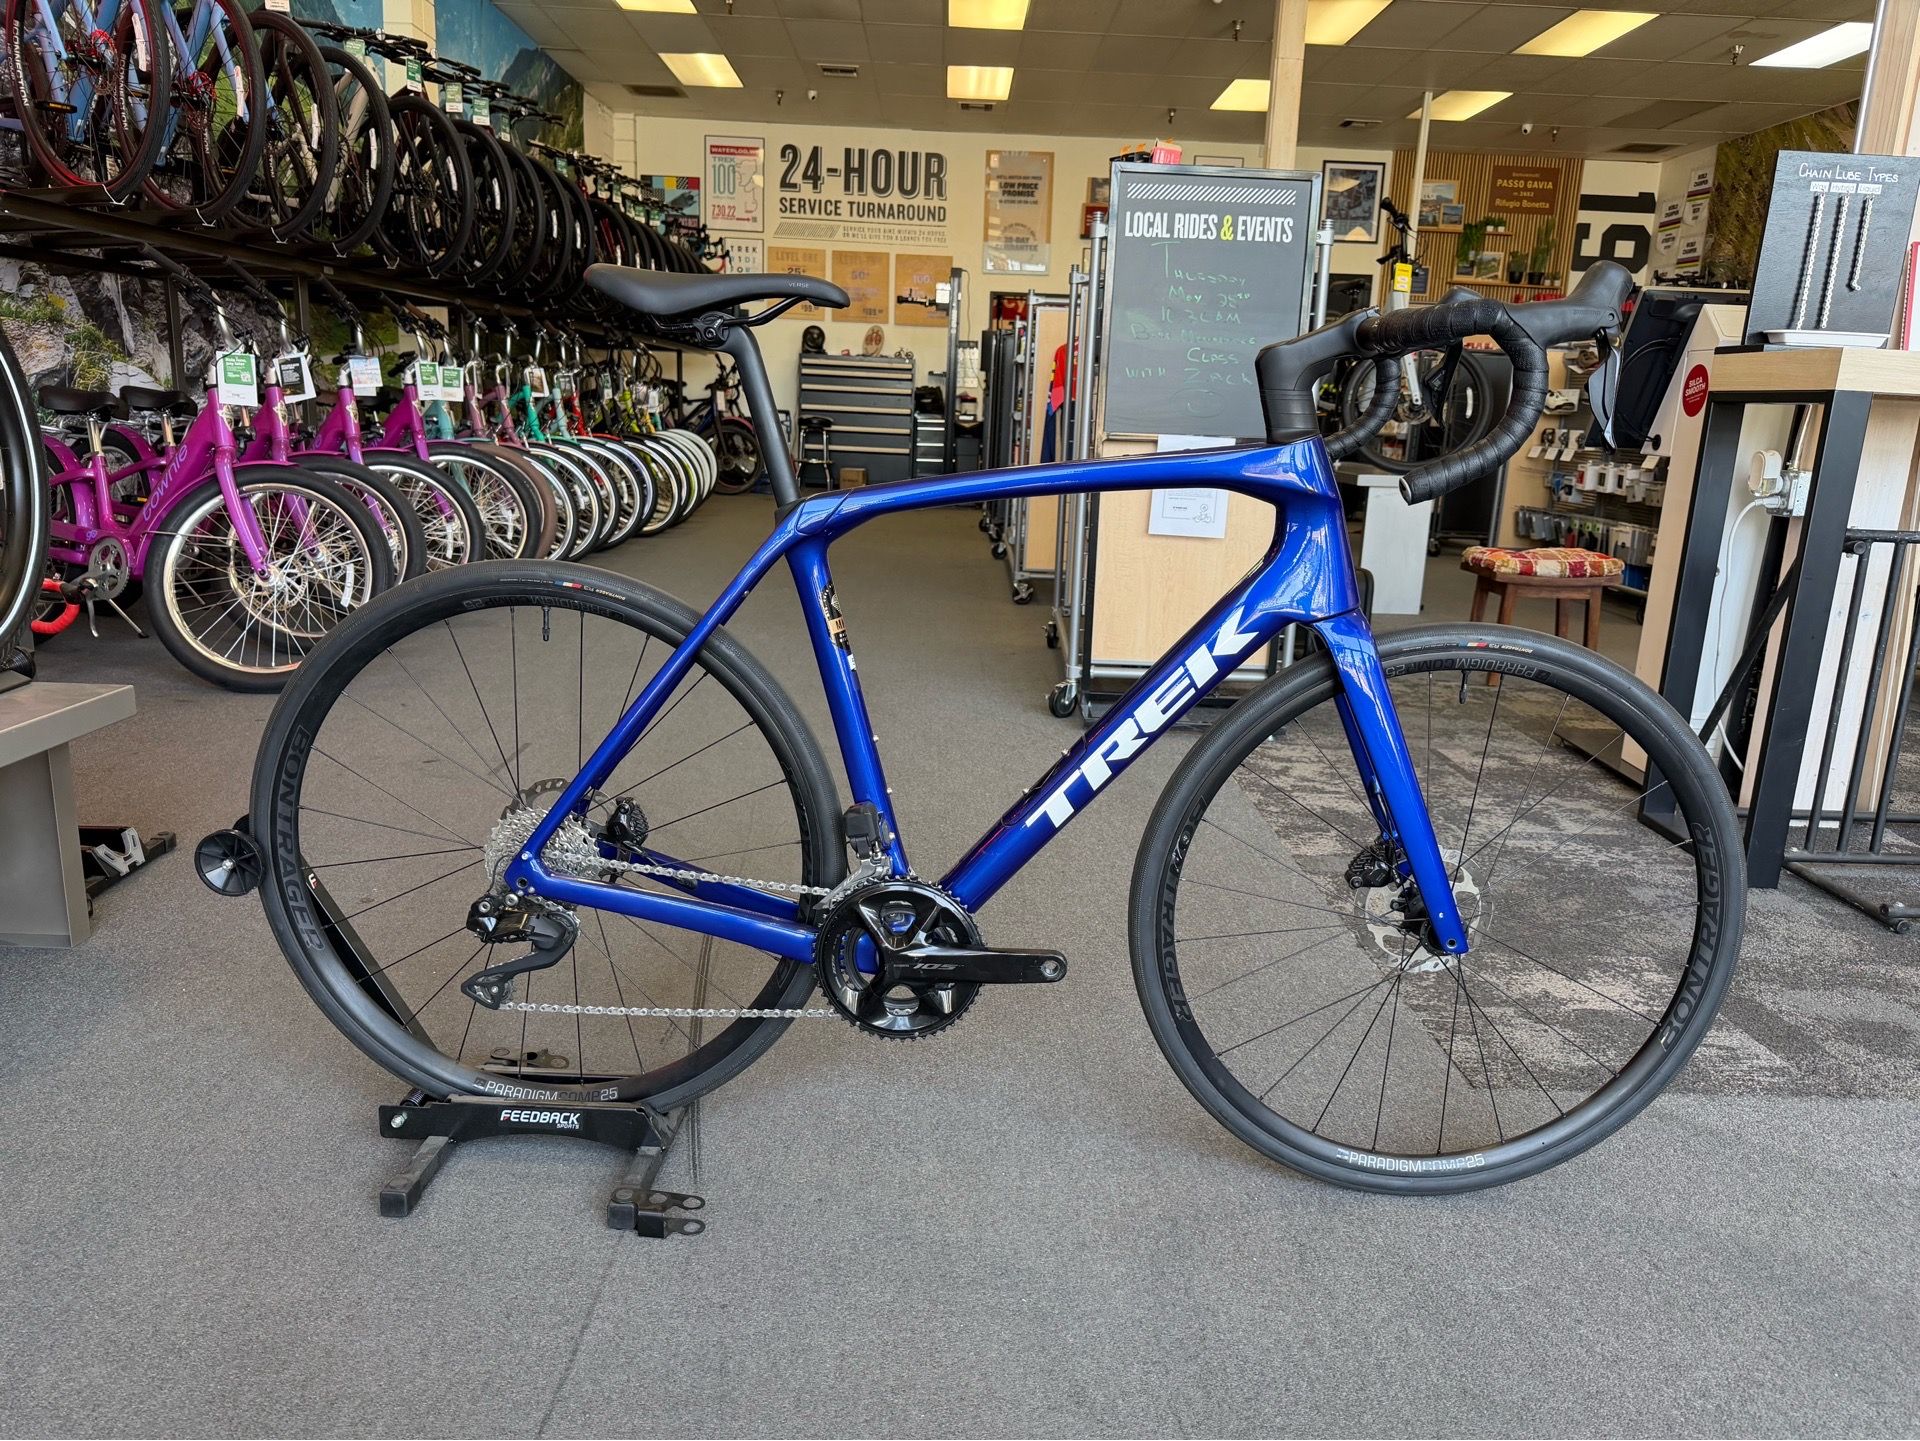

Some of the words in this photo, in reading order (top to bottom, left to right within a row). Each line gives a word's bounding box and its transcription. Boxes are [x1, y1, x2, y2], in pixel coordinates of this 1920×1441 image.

[14, 26, 29, 107] CONNECTION
[712, 163, 736, 195] 100
[779, 143, 948, 201] 24-HOUR
[1798, 162, 1833, 179] CHAIN
[1835, 164, 1862, 180] LUBE
[1868, 166, 1899, 183] TYPES
[999, 182, 1016, 190] LOW
[1002, 190, 1036, 198] PROMISE
[1496, 178, 1525, 189] PASSO
[1526, 179, 1553, 189] GAVIA
[779, 197, 842, 217] SERVICE
[848, 201, 947, 222] TURNAROUND
[1494, 198, 1521, 209] Rifugio
[1124, 211, 1171, 239] LOCAL
[1173, 213, 1218, 240] RIDES
[1220, 215, 1234, 241] &
[1236, 215, 1294, 243] EVENTS
[788, 281, 810, 289] VERSE
[1685, 382, 1706, 397] SMOOTH
[1689, 376, 1703, 387] SILCA
[142, 444, 188, 522] townie
[1025, 605, 1260, 828] TREK
[276, 725, 326, 951] BONTRAGER
[1659, 822, 1721, 1053] BONTRAGER
[913, 962, 959, 971] 105
[500, 1109, 581, 1125] FEEDBACK
